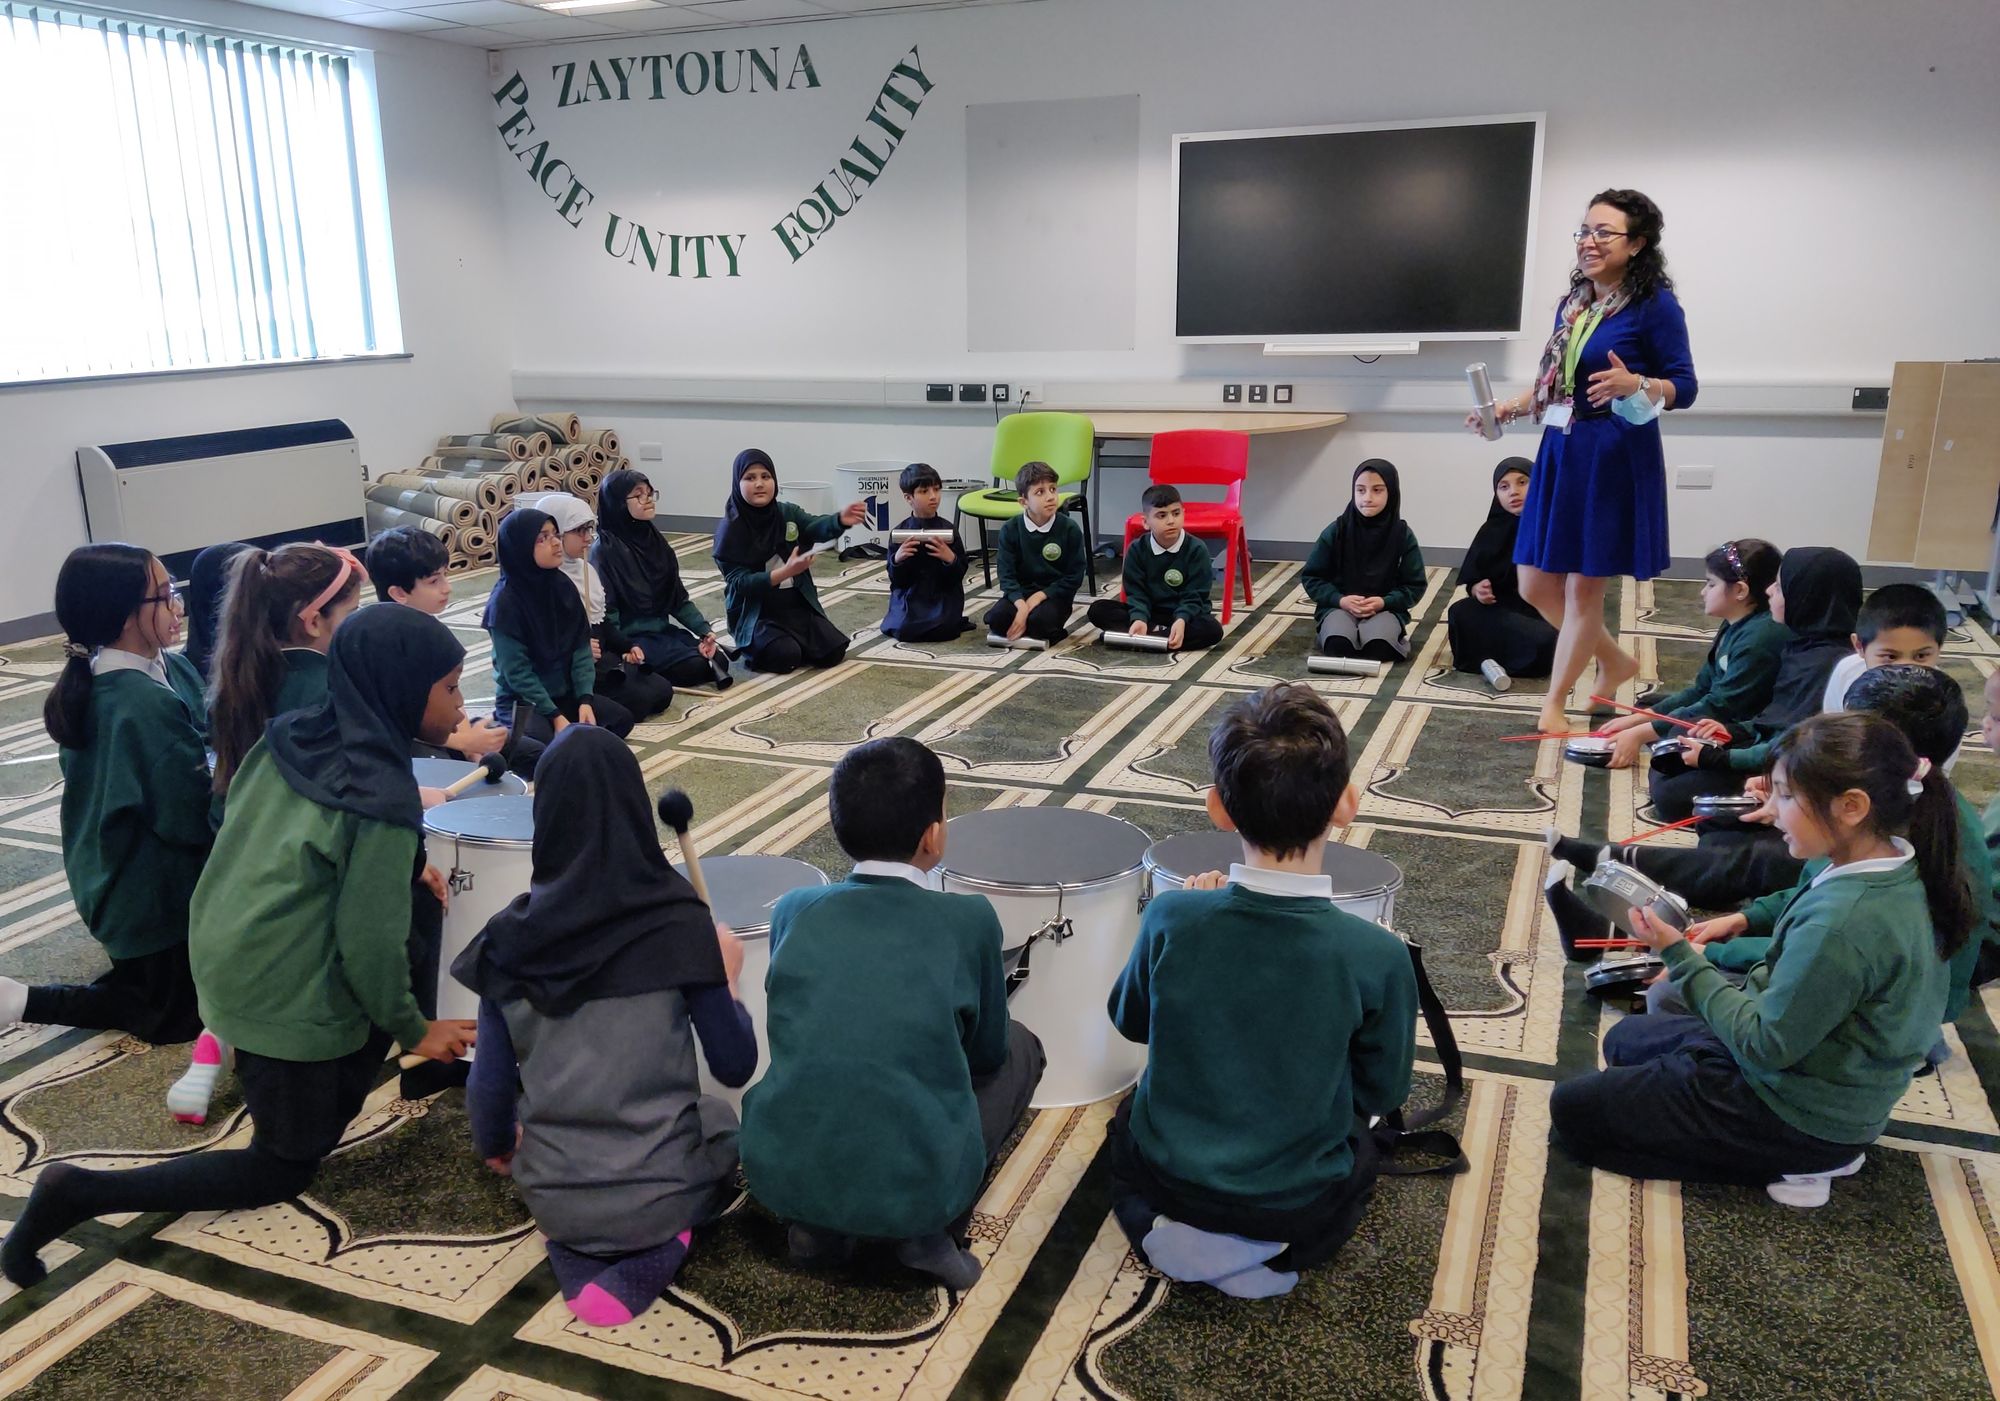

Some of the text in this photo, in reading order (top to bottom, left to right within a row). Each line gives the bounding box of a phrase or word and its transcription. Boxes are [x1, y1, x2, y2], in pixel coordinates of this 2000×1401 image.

[552, 44, 822, 108] ZAYTOUNA
[492, 44, 936, 279] PEACE UNITY EQUALITY
[858, 481, 889, 490] MUSIC
